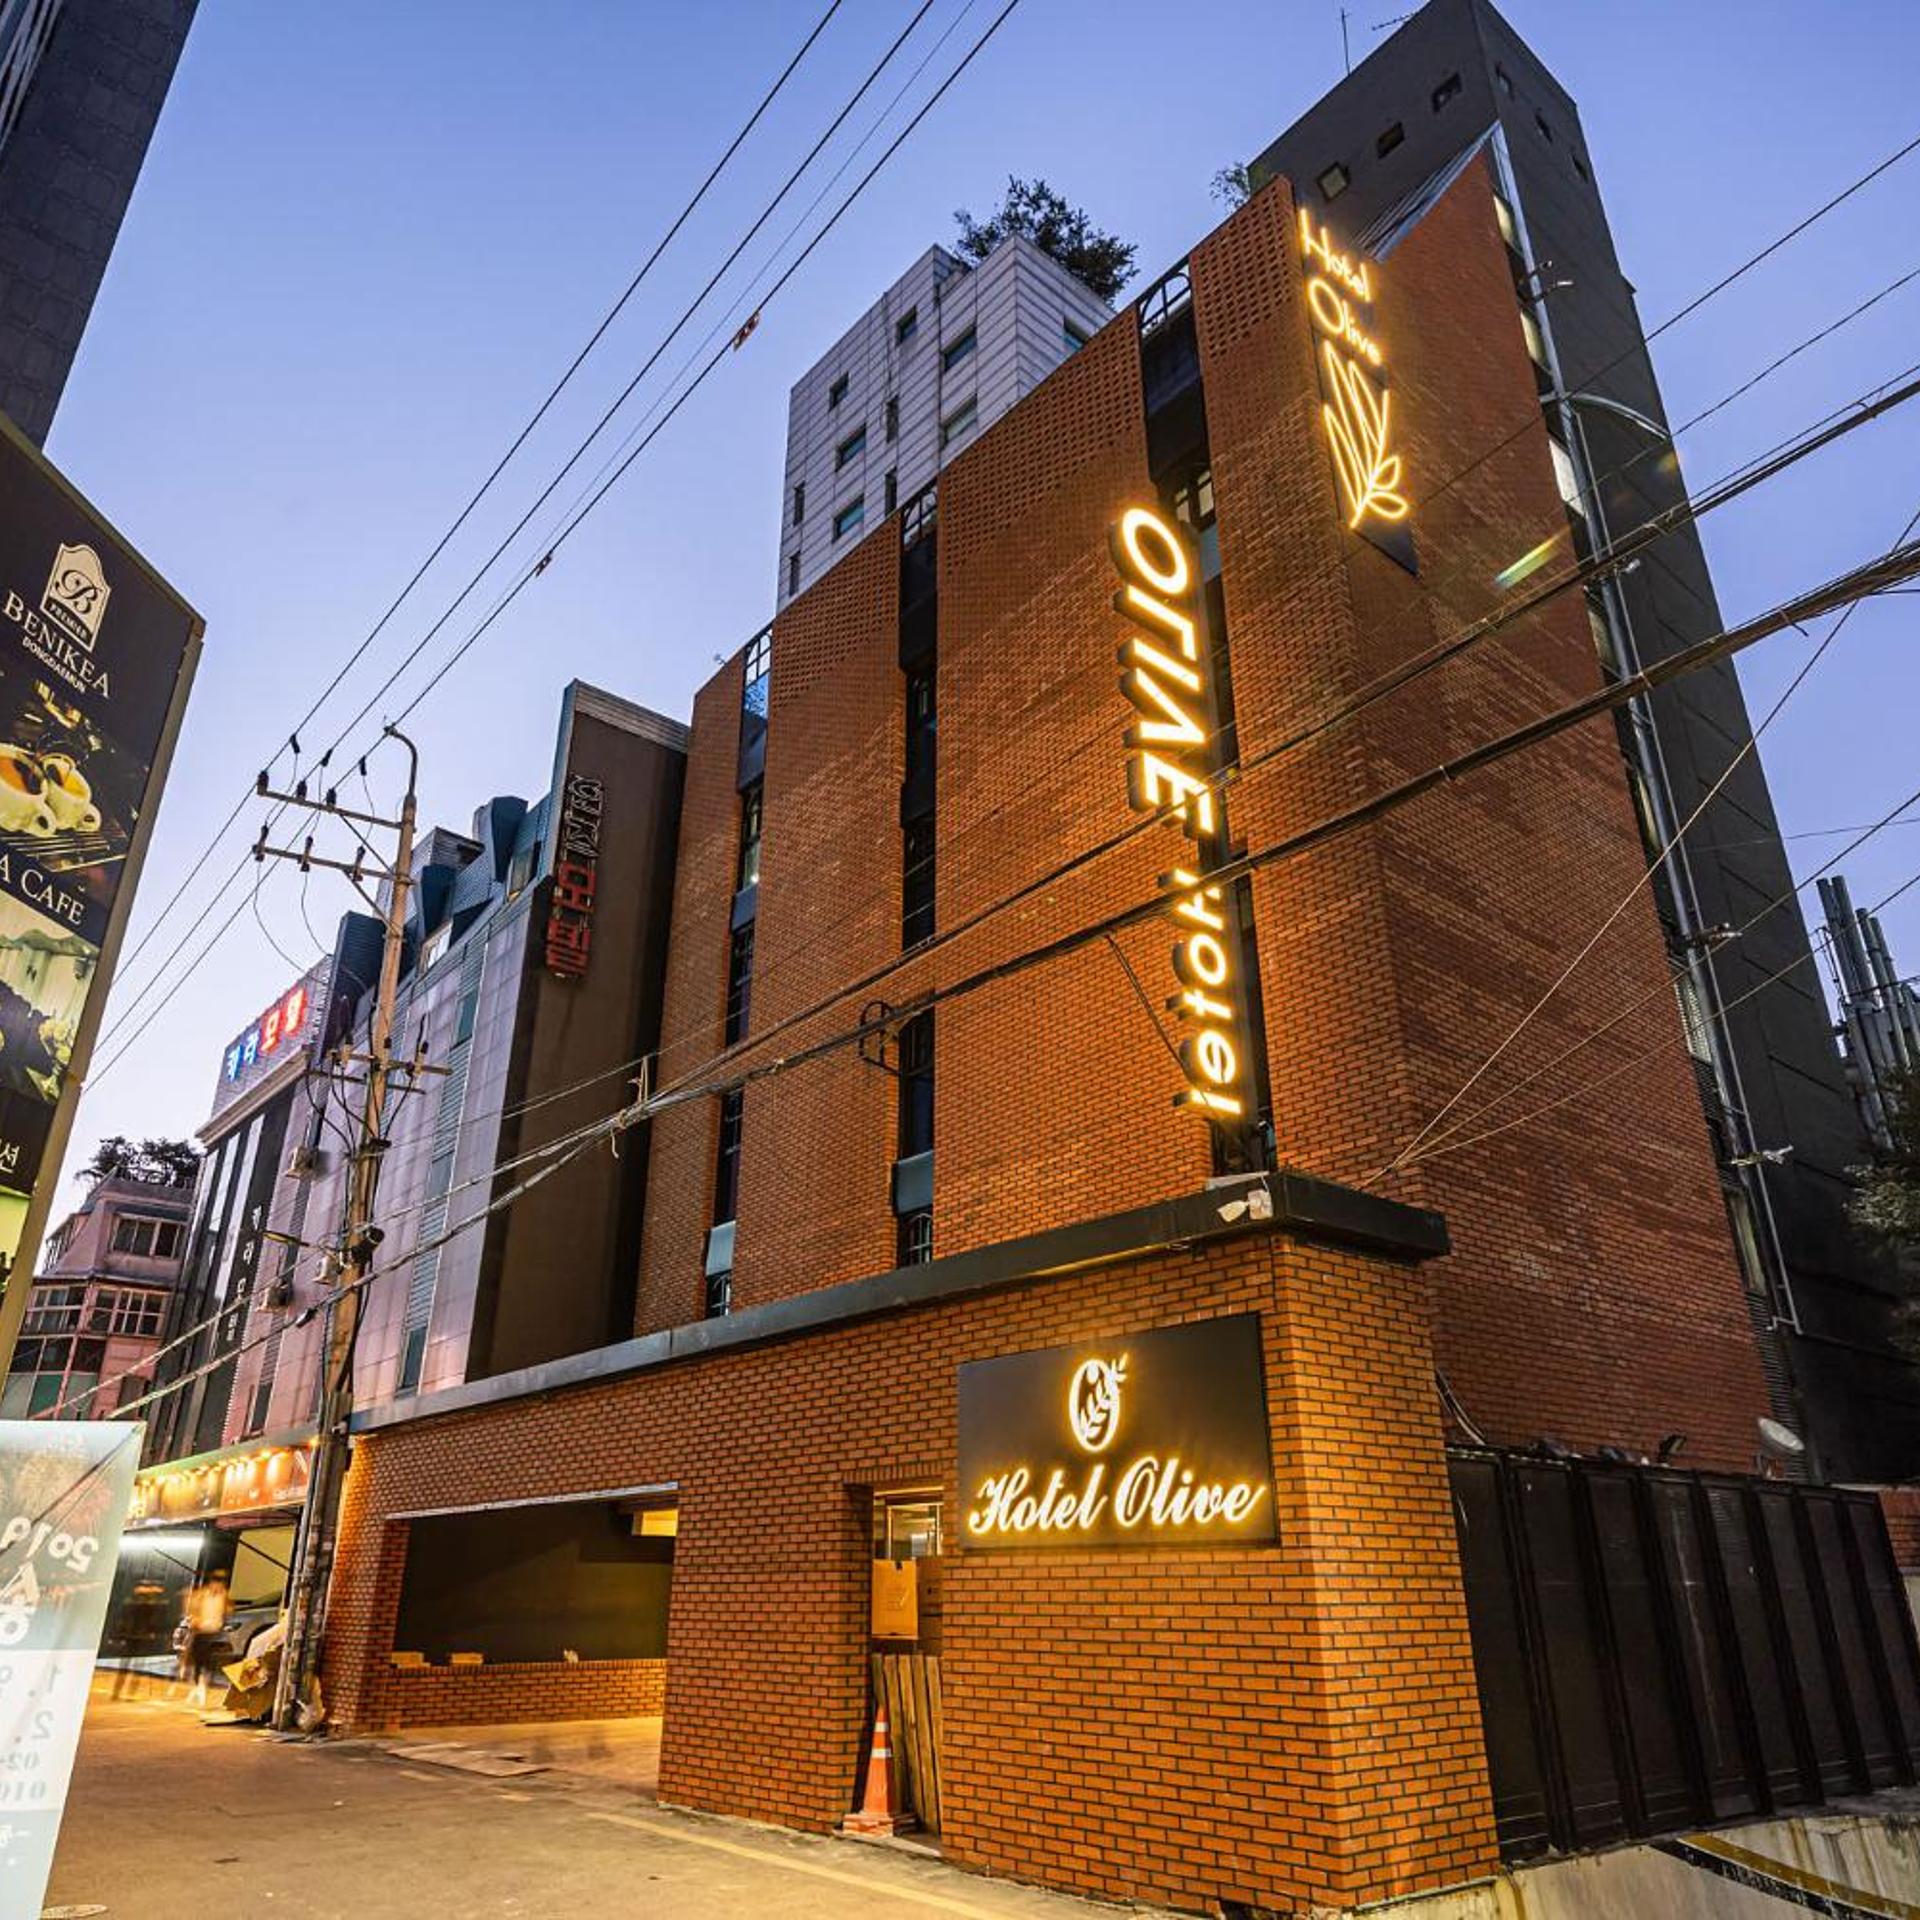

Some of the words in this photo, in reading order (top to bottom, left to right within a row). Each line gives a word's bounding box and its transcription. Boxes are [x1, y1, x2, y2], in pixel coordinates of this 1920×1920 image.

[1300, 208, 1371, 302] Hotel
[3, 590, 110, 698] BENIKEA
[49, 603, 88, 640] PREMIER
[22, 635, 86, 693] DONGDAEMUN
[21, 868, 84, 925] CAFE
[967, 1462, 1108, 1535] Hotel
[1115, 1455, 1267, 1528] Olive
